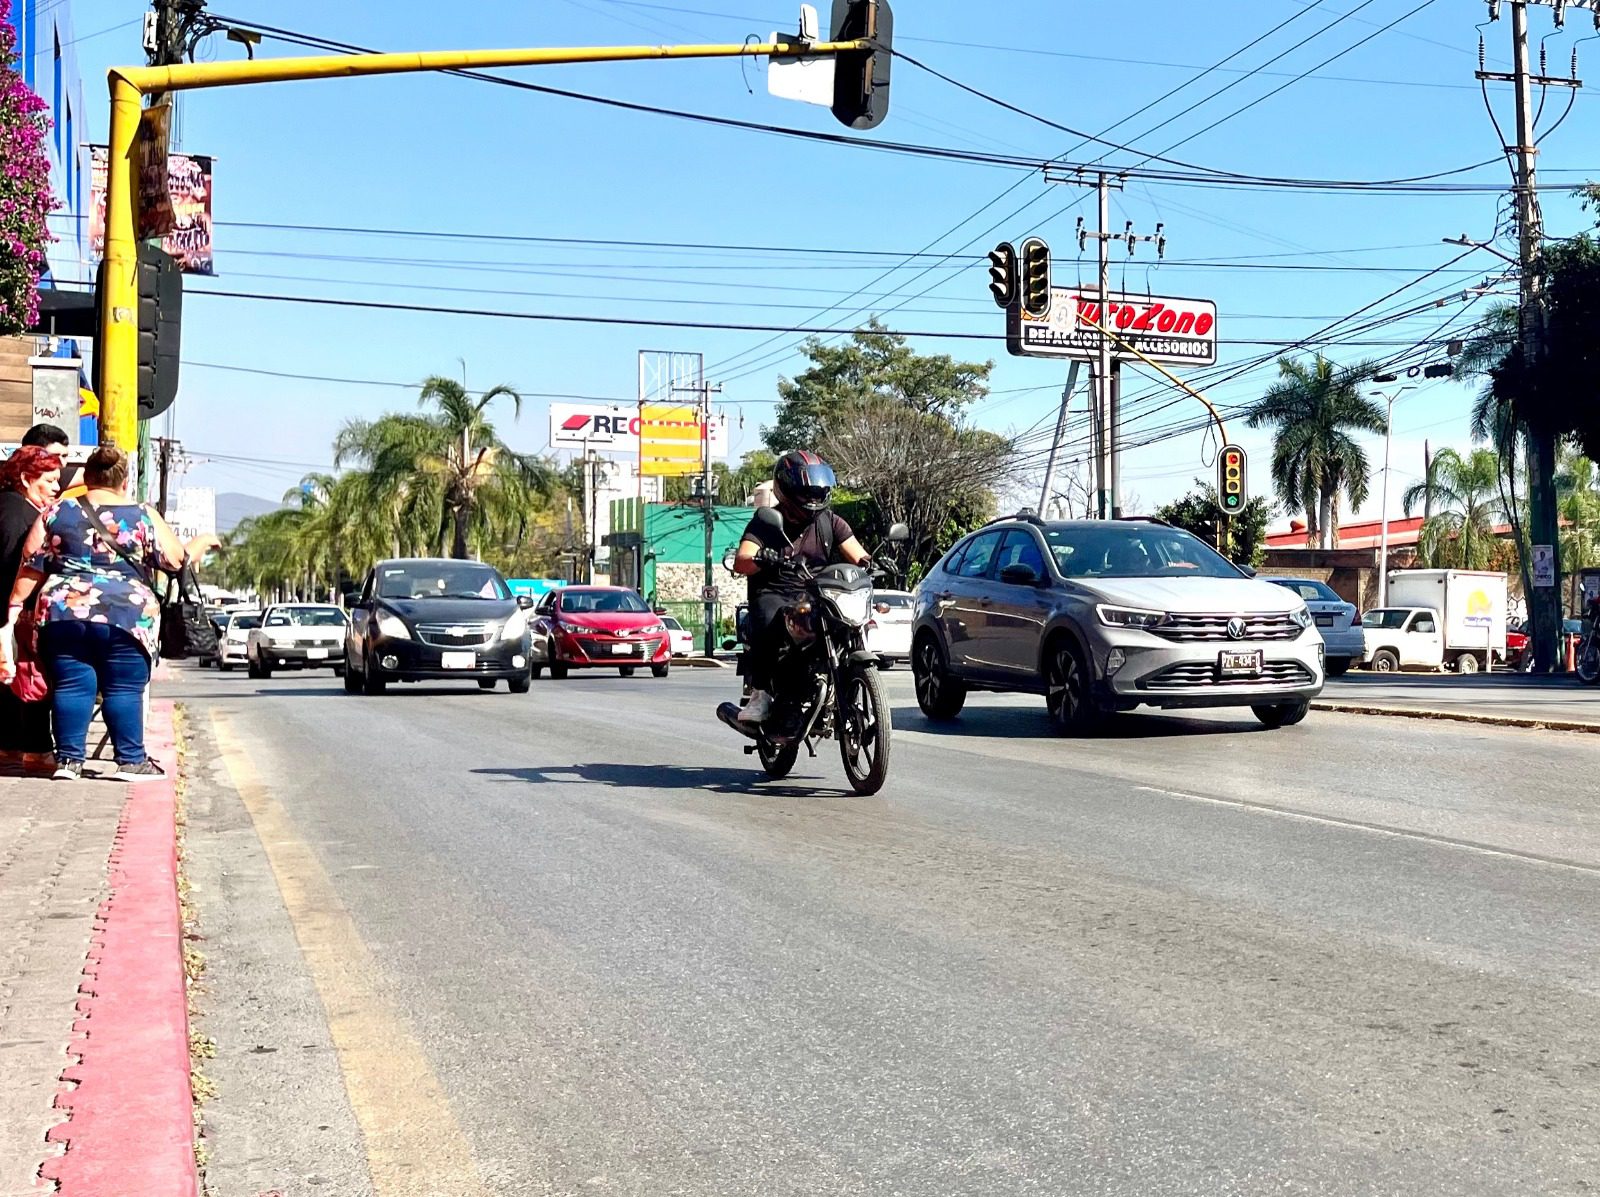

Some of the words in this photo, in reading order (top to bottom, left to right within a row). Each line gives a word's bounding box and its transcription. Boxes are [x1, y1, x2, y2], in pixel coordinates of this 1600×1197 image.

[1068, 295, 1214, 336] uoZone
[1028, 328, 1117, 349] REFACCION
[1134, 336, 1208, 356] ACCESORIOS
